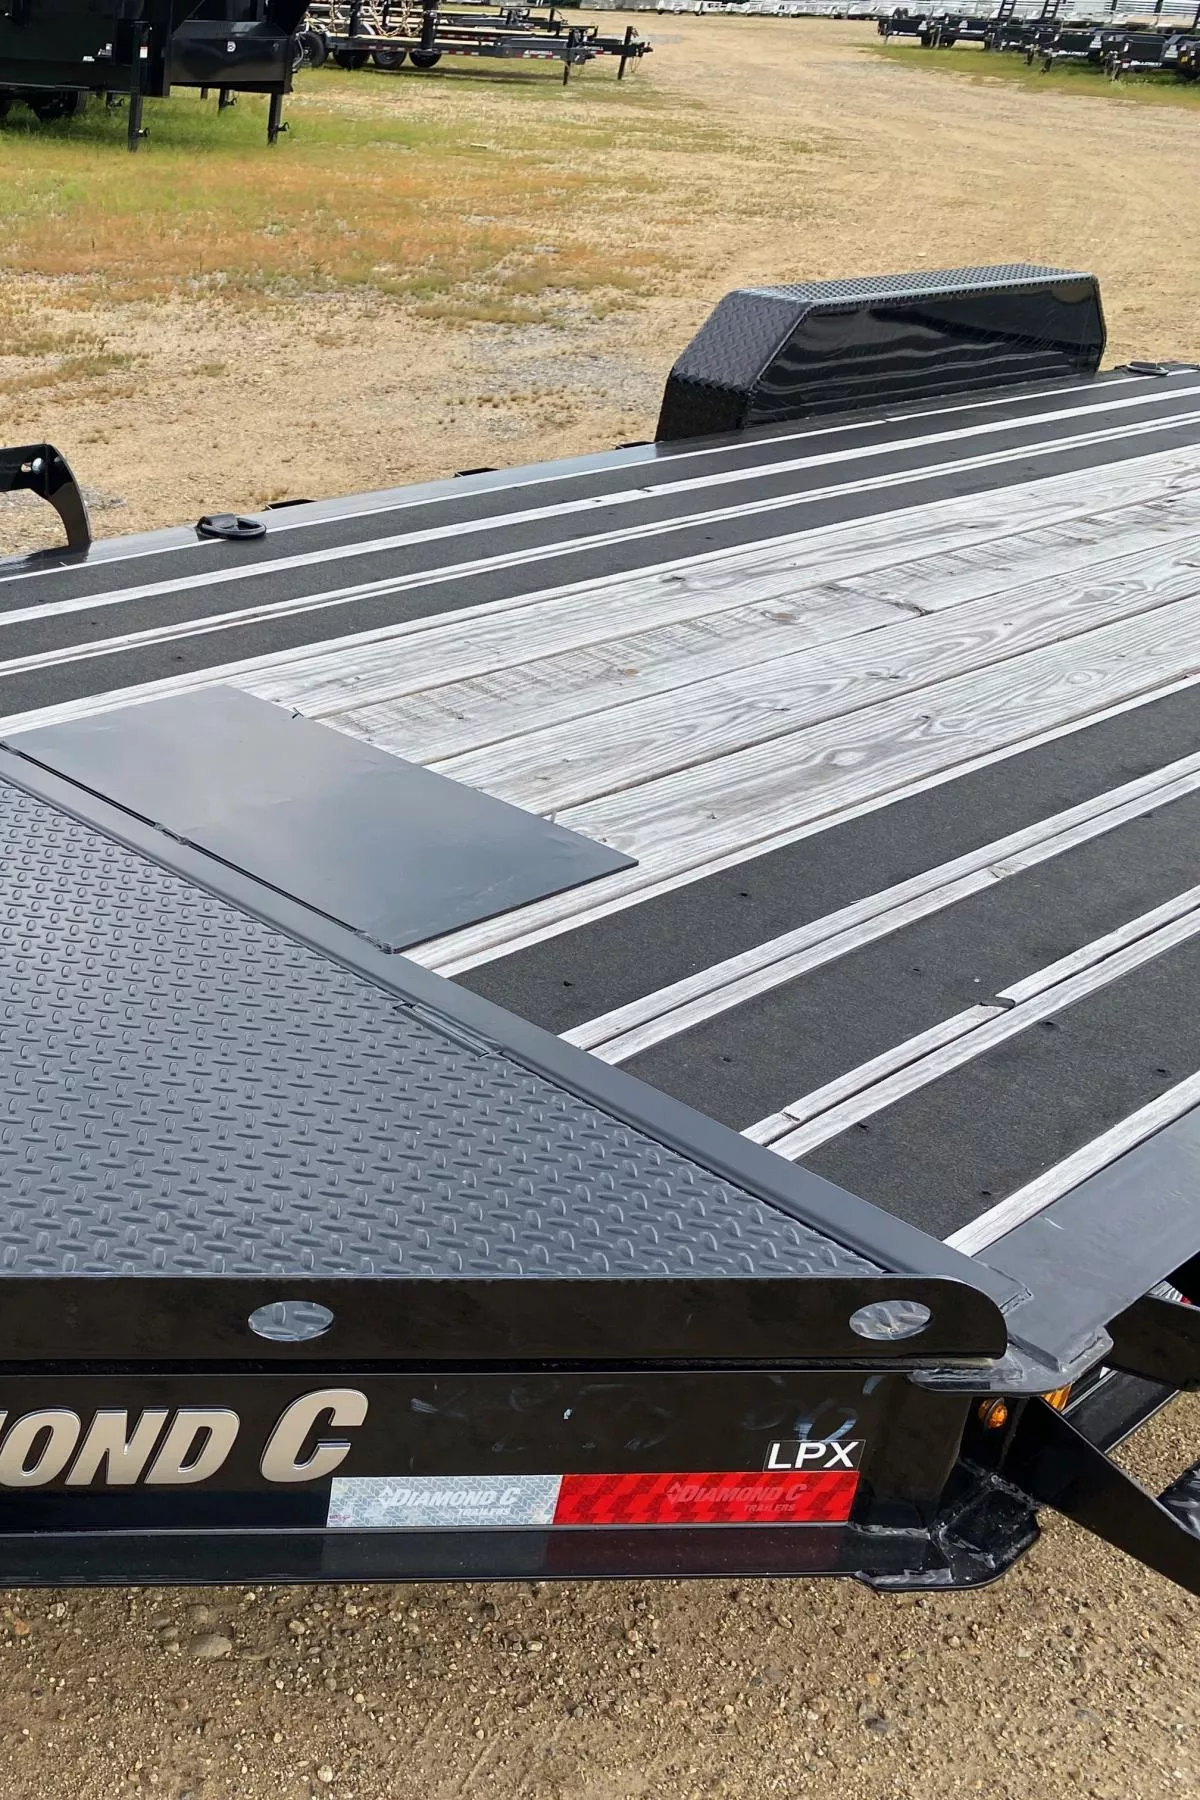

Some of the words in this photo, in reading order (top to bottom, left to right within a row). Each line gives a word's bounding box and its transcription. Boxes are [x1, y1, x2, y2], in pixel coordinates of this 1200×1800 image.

[260, 1388, 368, 1483] C
[768, 1441, 859, 1469] LPX
[388, 1488, 498, 1507] DIAMOND
[499, 1487, 520, 1505] C
[678, 1485, 785, 1503] DIAMOND
[785, 1483, 808, 1501] C
[744, 1503, 796, 1512] TRAILERS
